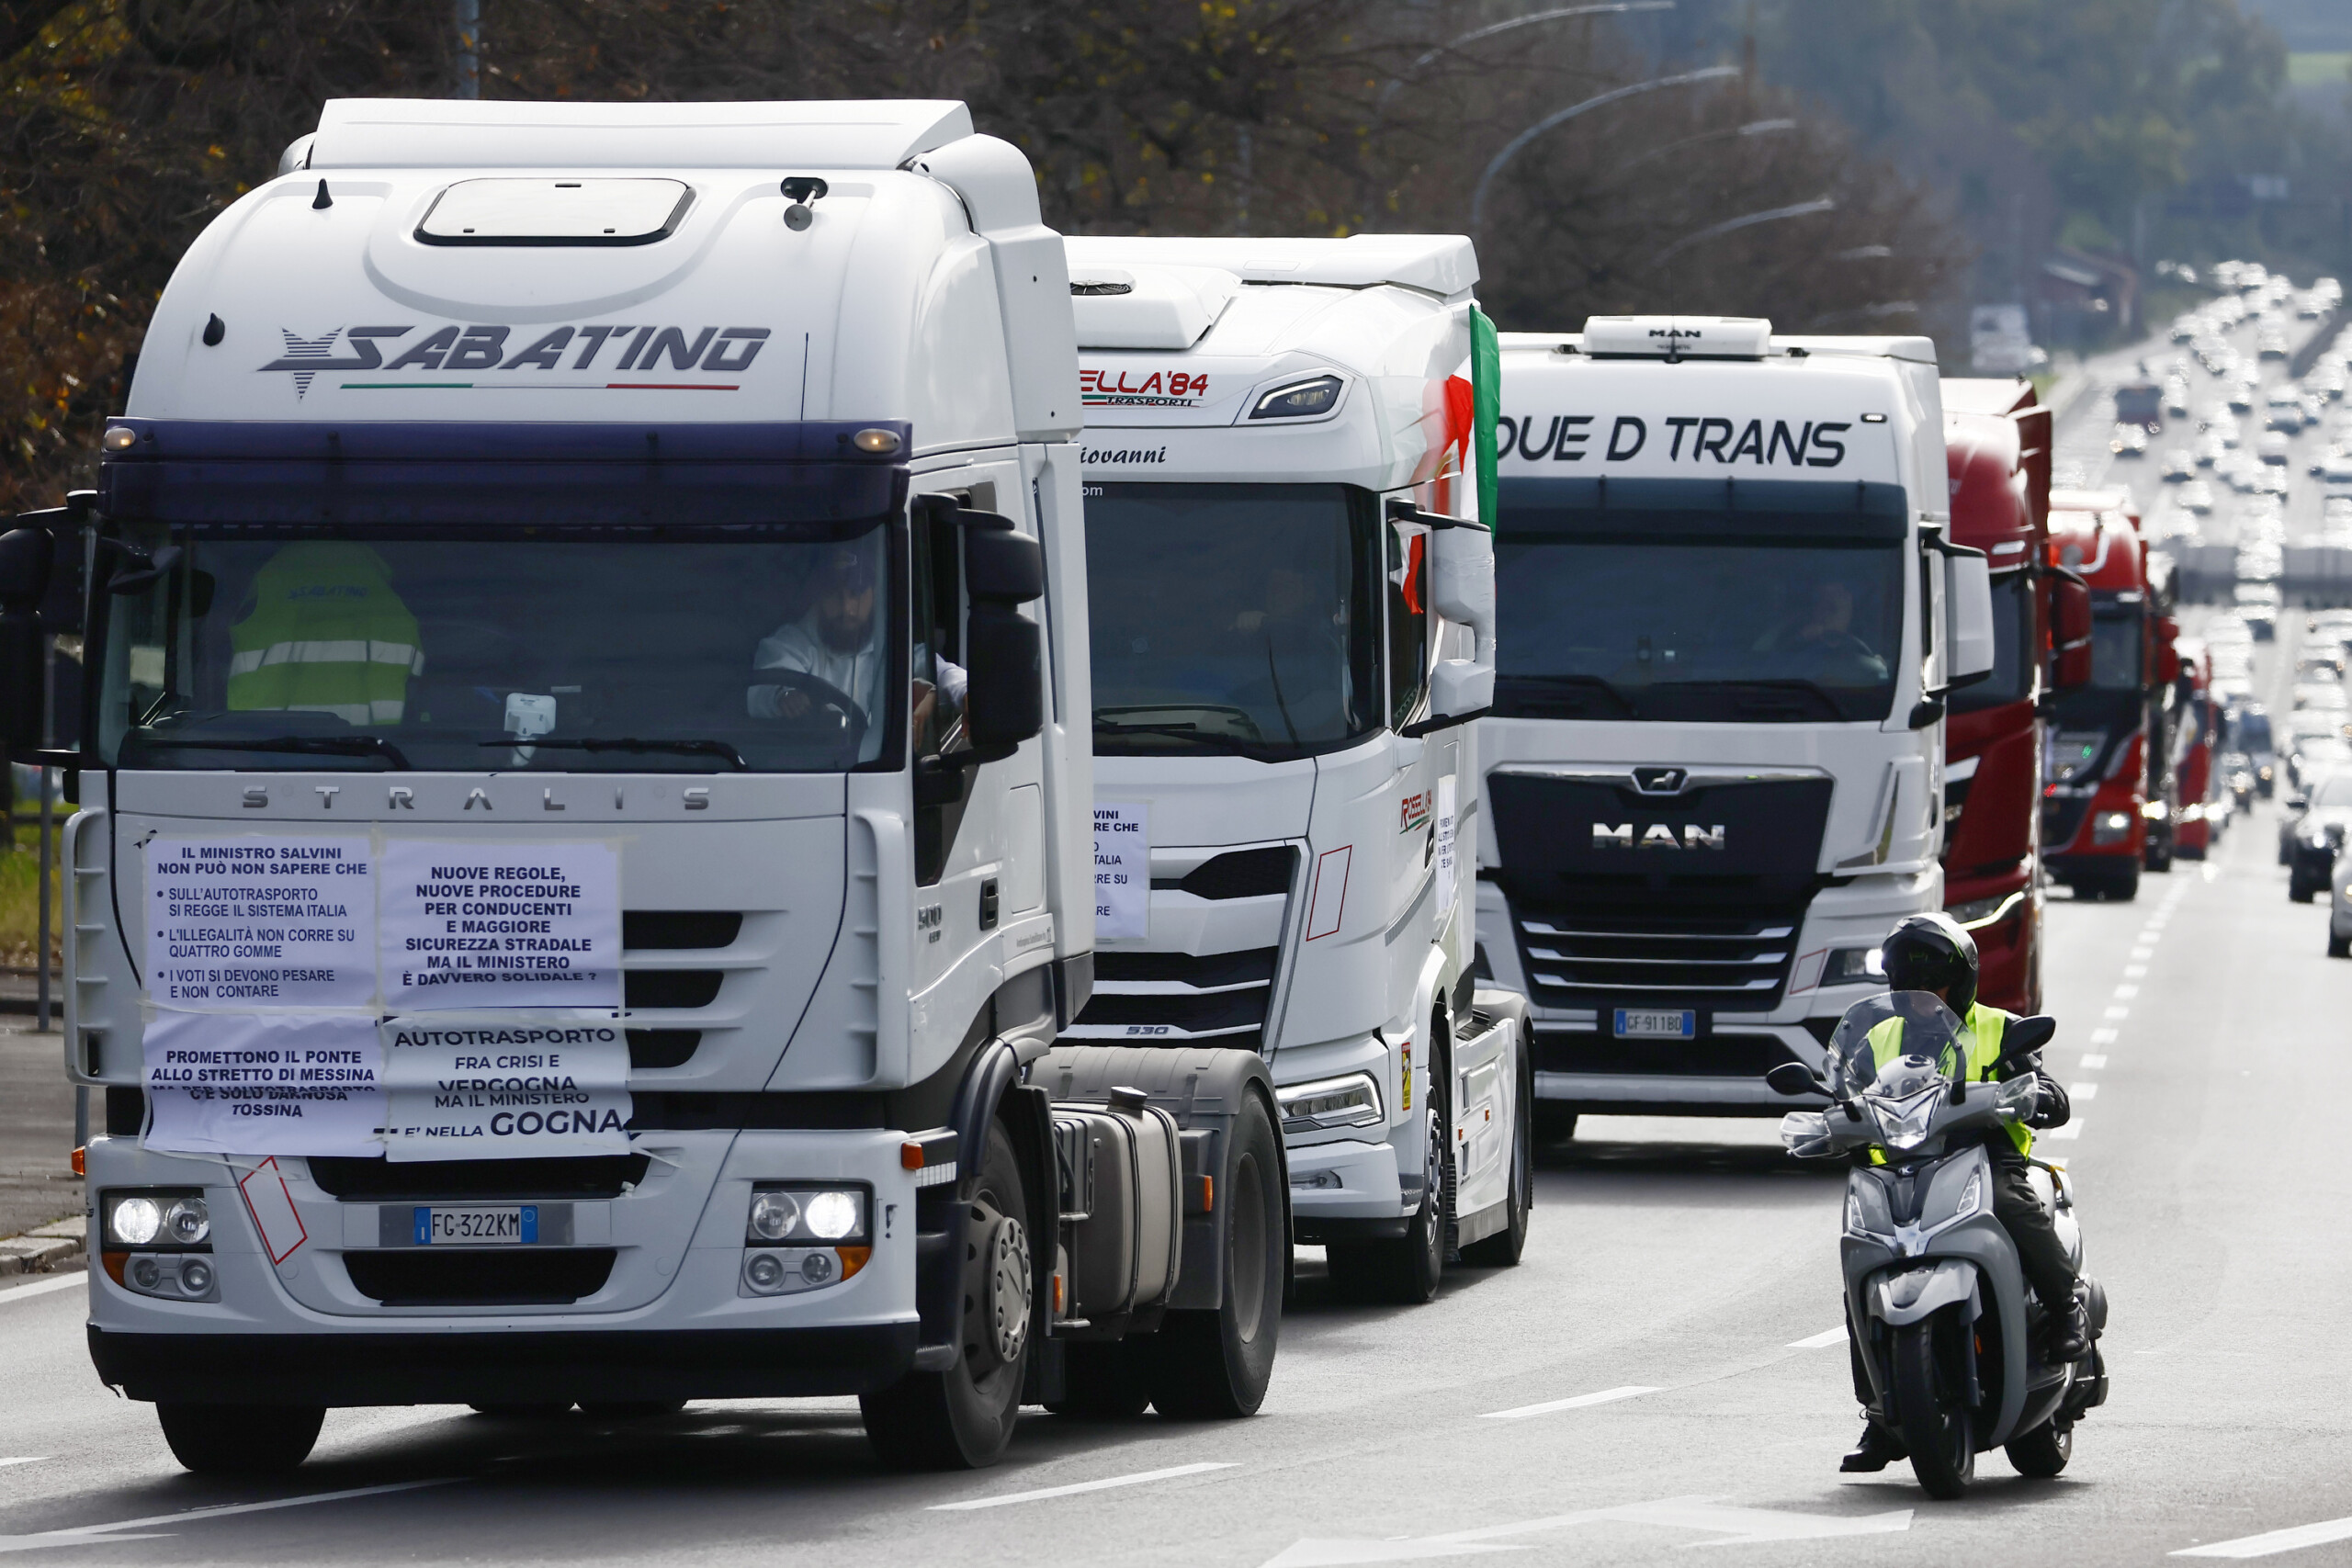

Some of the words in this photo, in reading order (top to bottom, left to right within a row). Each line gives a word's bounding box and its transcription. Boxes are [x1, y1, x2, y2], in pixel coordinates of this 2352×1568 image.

[1648, 330, 1702, 338] MAN
[256, 325, 772, 372] SABATINO
[1080, 370, 1209, 397] ELLA'84
[1106, 396, 1193, 407] TRASPORTI
[1606, 416, 1647, 461] D
[1666, 417, 1852, 468] TRANS
[1080, 446, 1167, 464] iovanni
[243, 786, 709, 810] STRALIS
[1093, 810, 1119, 819] VINI
[1114, 823, 1139, 832] CHE
[1593, 822, 1724, 851] MAN
[182, 847, 196, 859] IL
[200, 847, 276, 860] MINISTRO
[280, 847, 342, 859] SALVINI
[1094, 854, 1123, 865] TALIA
[157, 863, 190, 874] NON
[195, 861, 227, 874] PUÒ
[232, 863, 265, 874] NON
[269, 863, 331, 874] SAPERE
[335, 863, 368, 874] CHE
[431, 866, 489, 880] NUOVE
[494, 866, 566, 883] REGOLE,
[1114, 874, 1128, 885] SU
[416, 885, 474, 897] NUOVE
[480, 885, 582, 898] PROCEDURE
[169, 904, 181, 917] SI
[184, 904, 229, 917] REGGE
[233, 905, 244, 917] IL
[248, 905, 304, 917] SISTEMA
[307, 905, 347, 917] ITALIA
[424, 903, 458, 915] PER
[462, 903, 572, 916] CONDUCENTI
[447, 920, 457, 933] E
[462, 920, 551, 933] MAGGIORE
[169, 926, 254, 942] L'ILLEGALITÀ
[257, 929, 285, 942] NON
[288, 929, 334, 942] CORRE
[337, 930, 355, 942] SU
[169, 945, 230, 958] QUATTRO
[233, 945, 282, 958] GOMME
[405, 938, 500, 951] SICUREZZA
[504, 938, 593, 952] STRADALE
[427, 956, 452, 969] MA
[457, 956, 472, 969] IL
[477, 956, 571, 969] MINISTERO
[169, 970, 174, 982] I
[176, 970, 205, 982] VOTI
[209, 970, 221, 982] SI
[224, 970, 279, 982] DEVONO
[282, 970, 335, 982] PESARE
[402, 970, 413, 987] È
[417, 973, 497, 987] DAVVERO
[502, 972, 583, 982] SOLIDALE
[588, 972, 597, 981] ?
[170, 986, 178, 998] E
[182, 986, 209, 998] NON
[216, 985, 279, 998] CONTARE
[1125, 1026, 1170, 1035] 530
[394, 1028, 616, 1048] AUTOTRASPORTO
[166, 1051, 280, 1064] PROMETTONO
[285, 1051, 300, 1064] IL
[305, 1051, 362, 1064] PONTE
[455, 1055, 492, 1070] FRA
[496, 1055, 543, 1068] CRISI
[549, 1055, 560, 1067] E
[151, 1068, 193, 1082] ALLO
[198, 1068, 274, 1082] STRETTO
[278, 1068, 296, 1081] DI
[300, 1068, 375, 1082] MESSINA
[435, 1095, 464, 1109] MA
[469, 1094, 485, 1107] IL
[490, 1093, 590, 1107] MINISTERO
[232, 1103, 303, 1118] TOSSINA
[425, 1125, 484, 1137] NELLA
[490, 1109, 625, 1136] GOGNA
